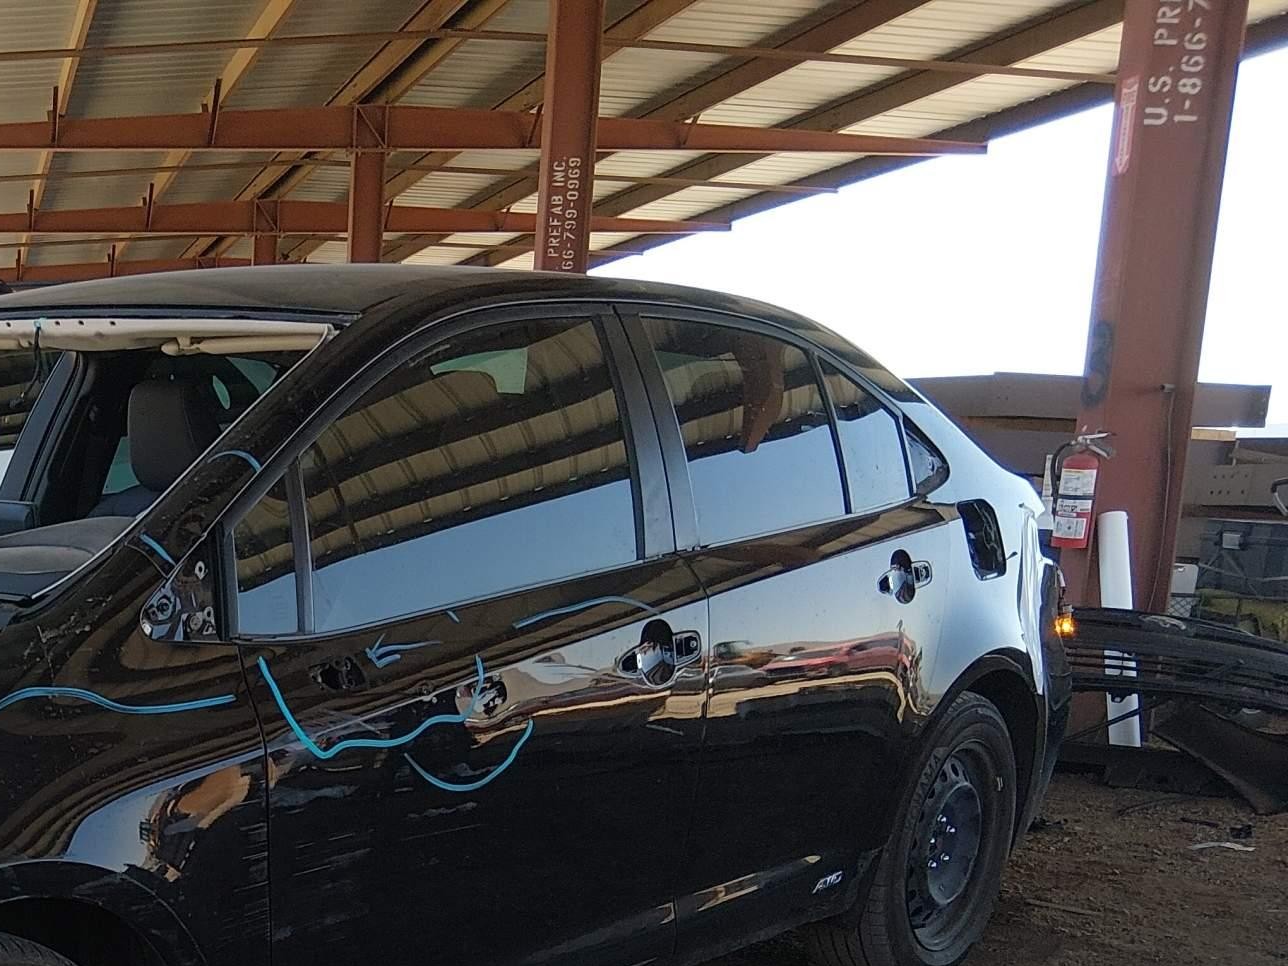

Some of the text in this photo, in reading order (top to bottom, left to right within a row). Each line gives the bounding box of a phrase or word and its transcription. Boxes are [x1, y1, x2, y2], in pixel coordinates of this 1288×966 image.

[1143, 0, 1182, 125] U.S. PR
[548, 195, 563, 257] PREFAB
